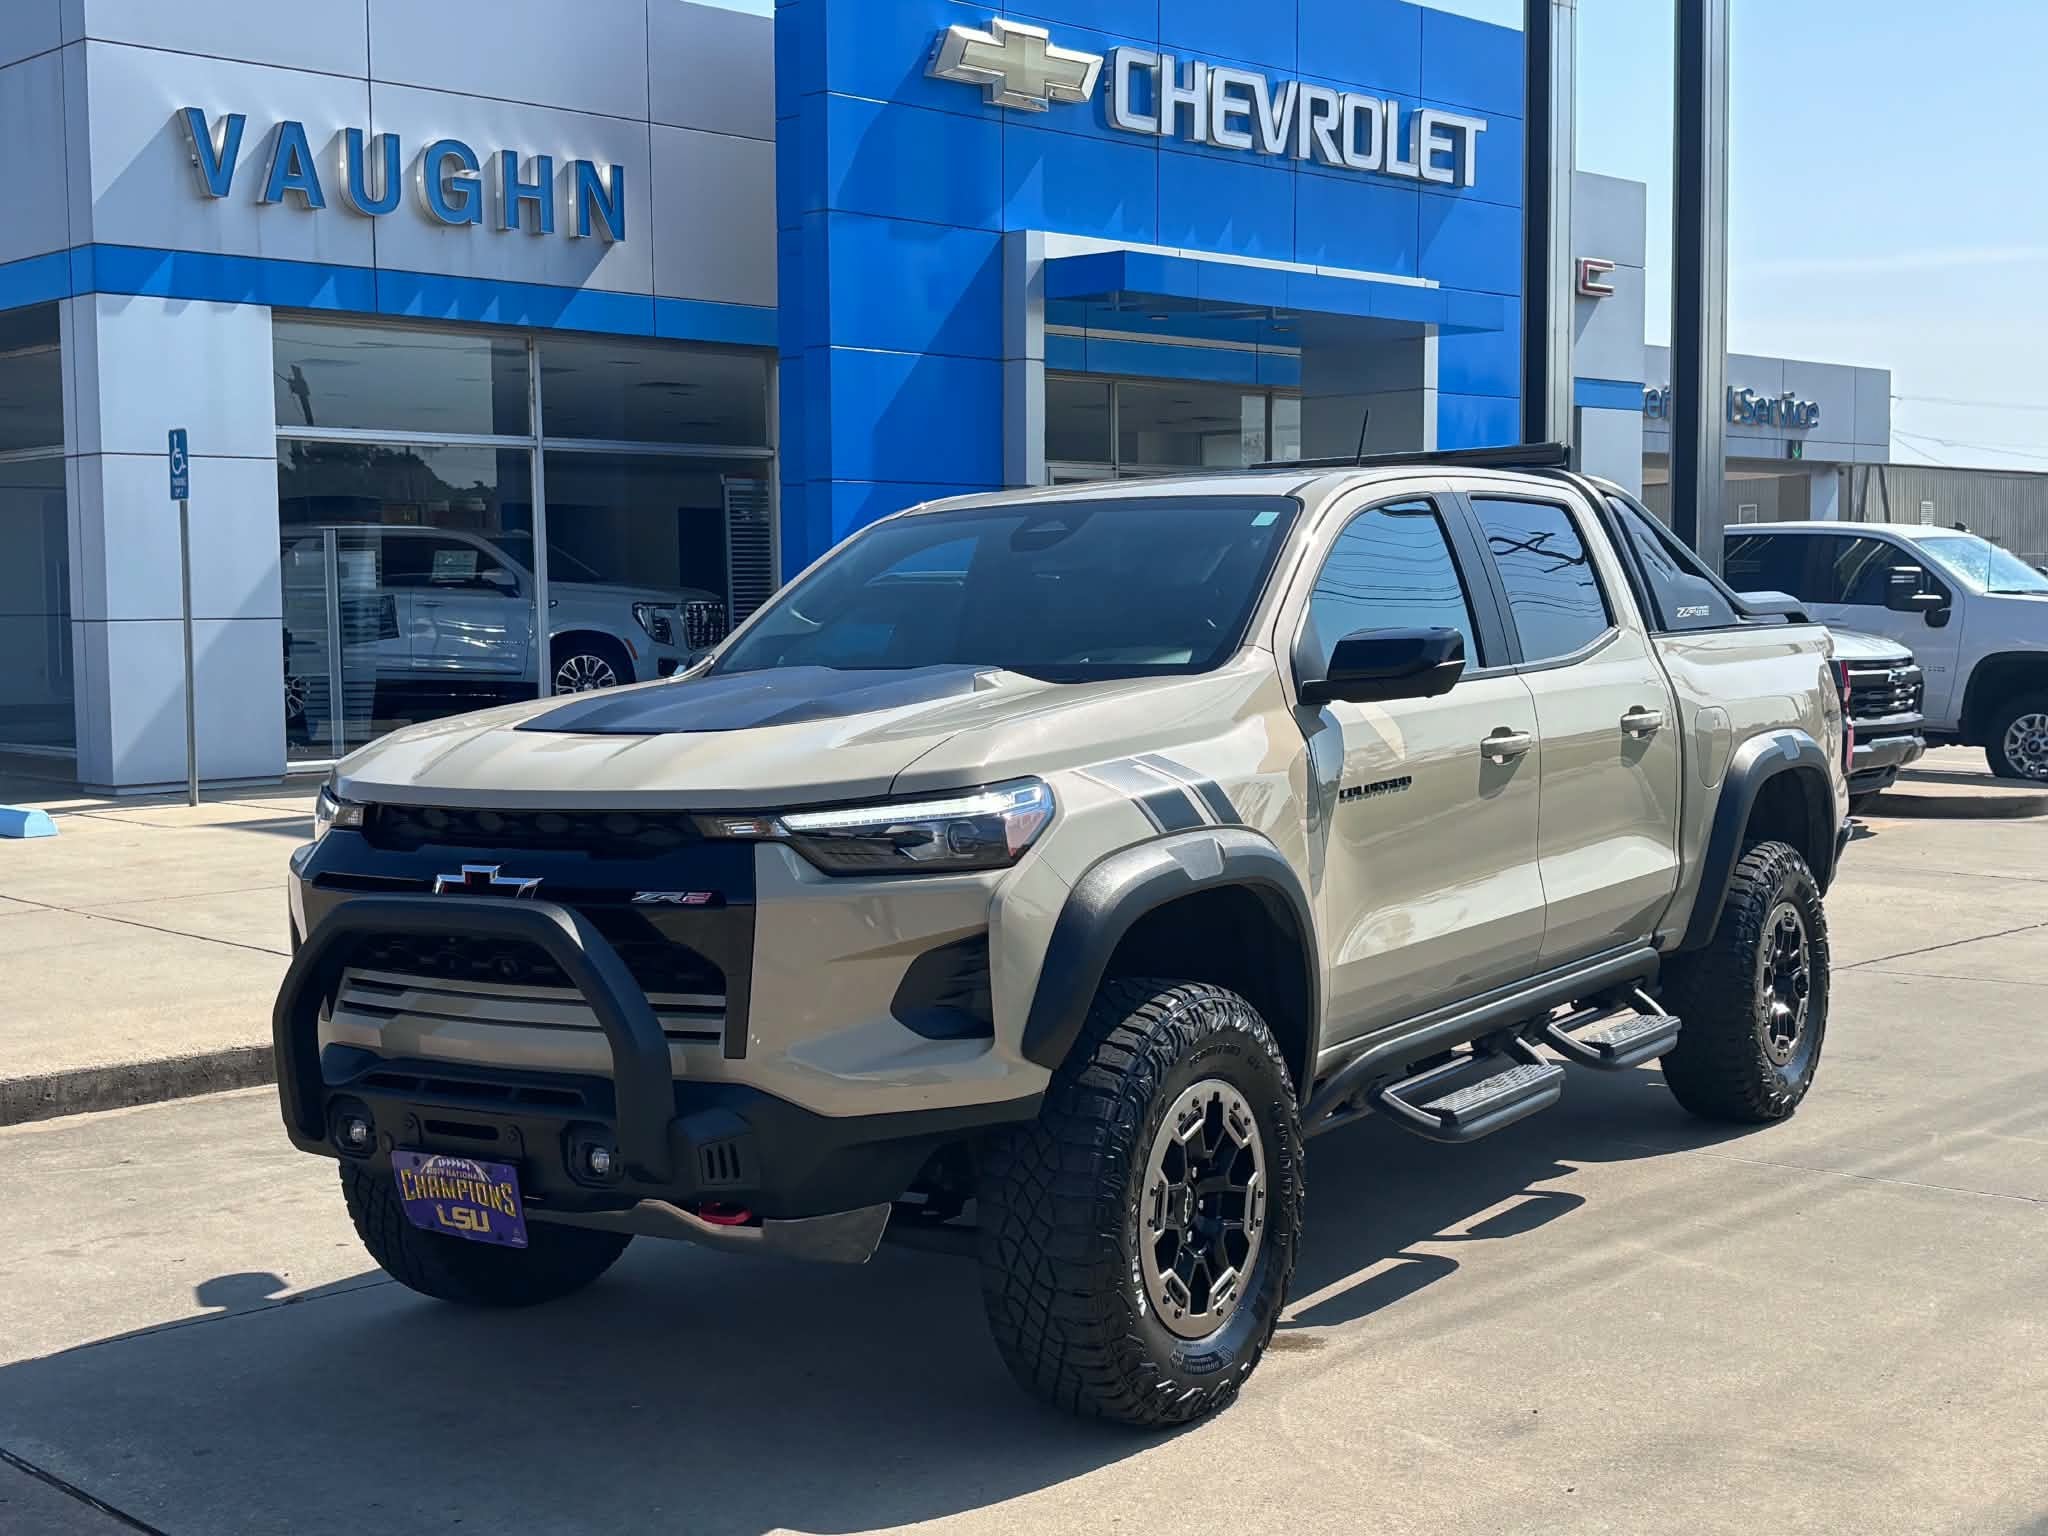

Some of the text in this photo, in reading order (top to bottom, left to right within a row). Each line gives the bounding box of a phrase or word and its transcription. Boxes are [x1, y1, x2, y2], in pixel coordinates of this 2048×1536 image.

[1105, 46, 1488, 188] CHEVROLET
[177, 106, 626, 243] VAUGHN
[1736, 388, 1820, 429] Service
[631, 891, 713, 904] ZR2
[400, 1168, 516, 1217] CHAMPIONS
[436, 1203, 492, 1232] LSU
